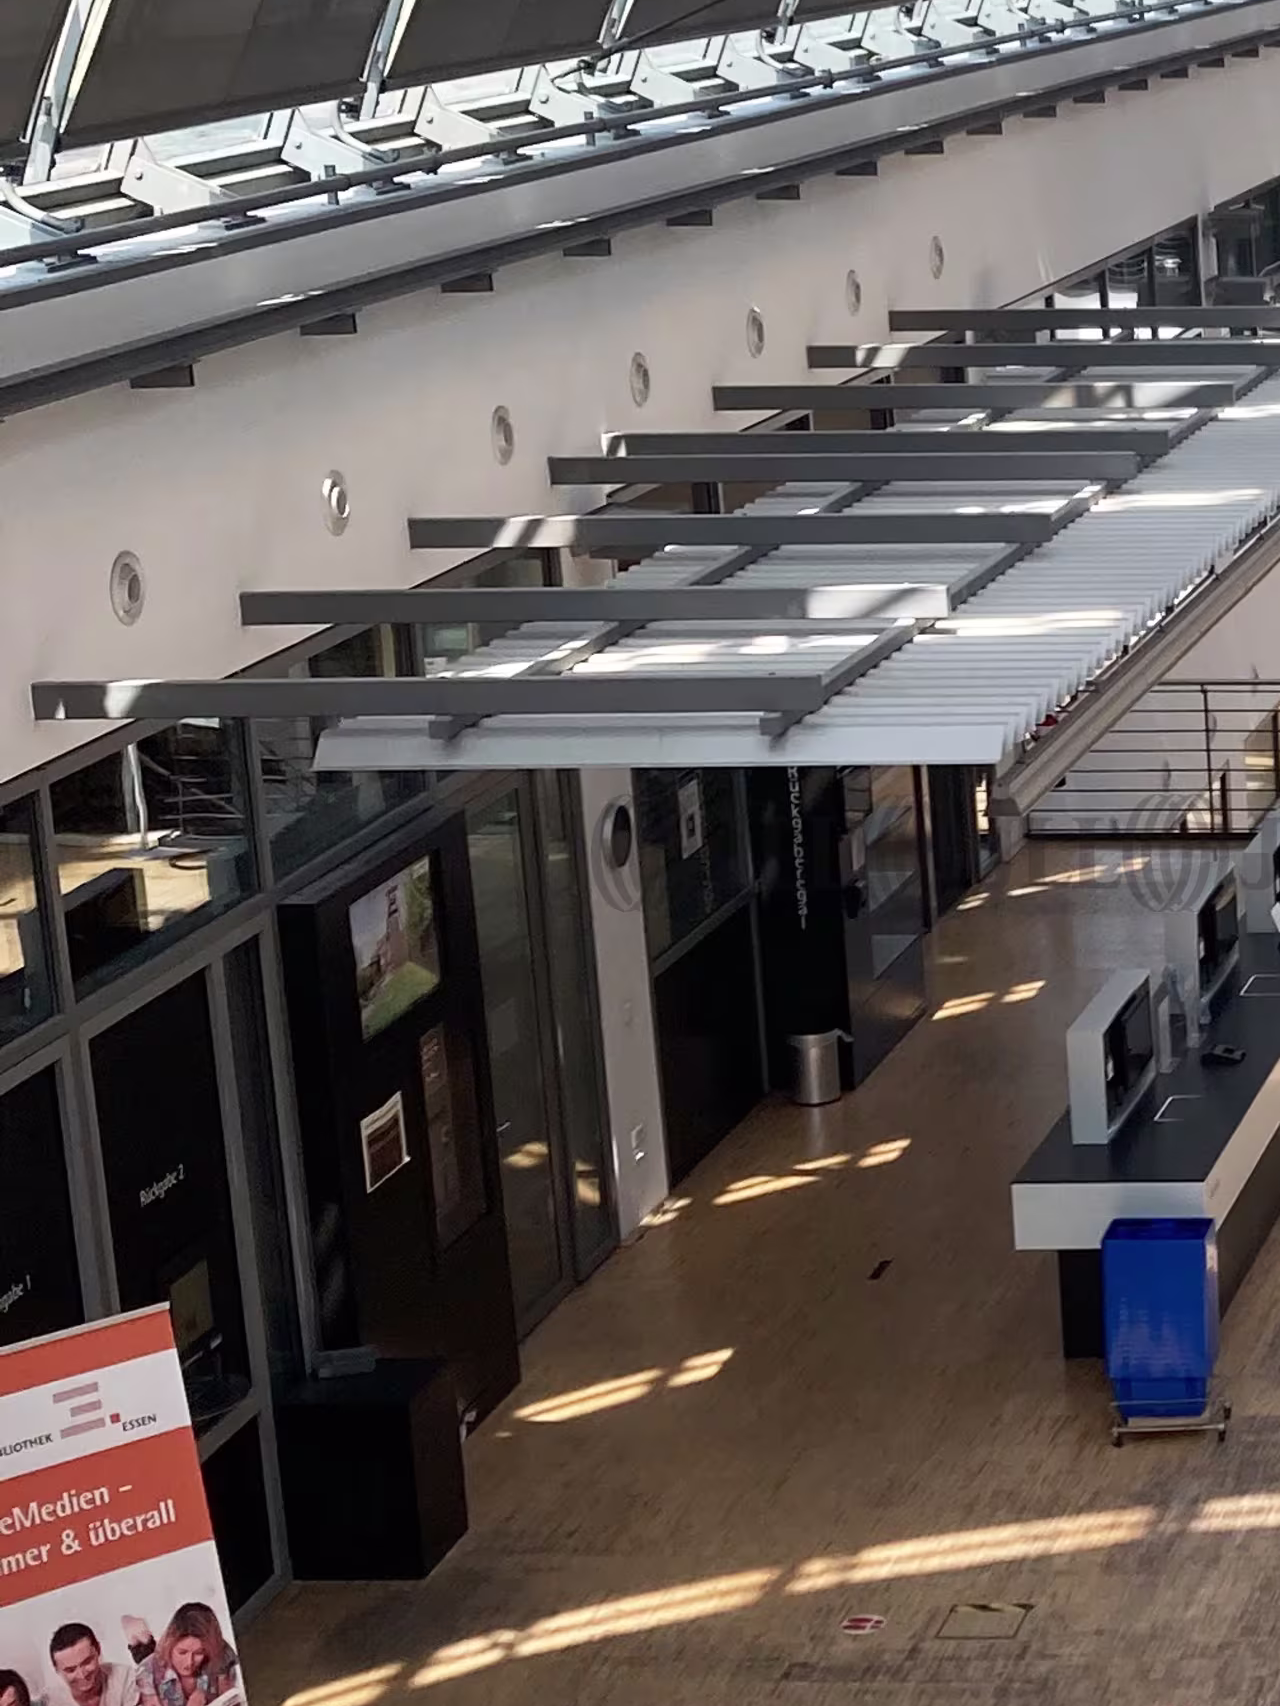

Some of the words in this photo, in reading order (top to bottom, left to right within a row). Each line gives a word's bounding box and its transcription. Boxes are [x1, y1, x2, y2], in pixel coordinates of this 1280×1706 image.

[122, 1413, 157, 1432] ESSEN
[0, 1486, 110, 1535] eMedien
[61, 1528, 82, 1555] &
[89, 1499, 176, 1546] überall
